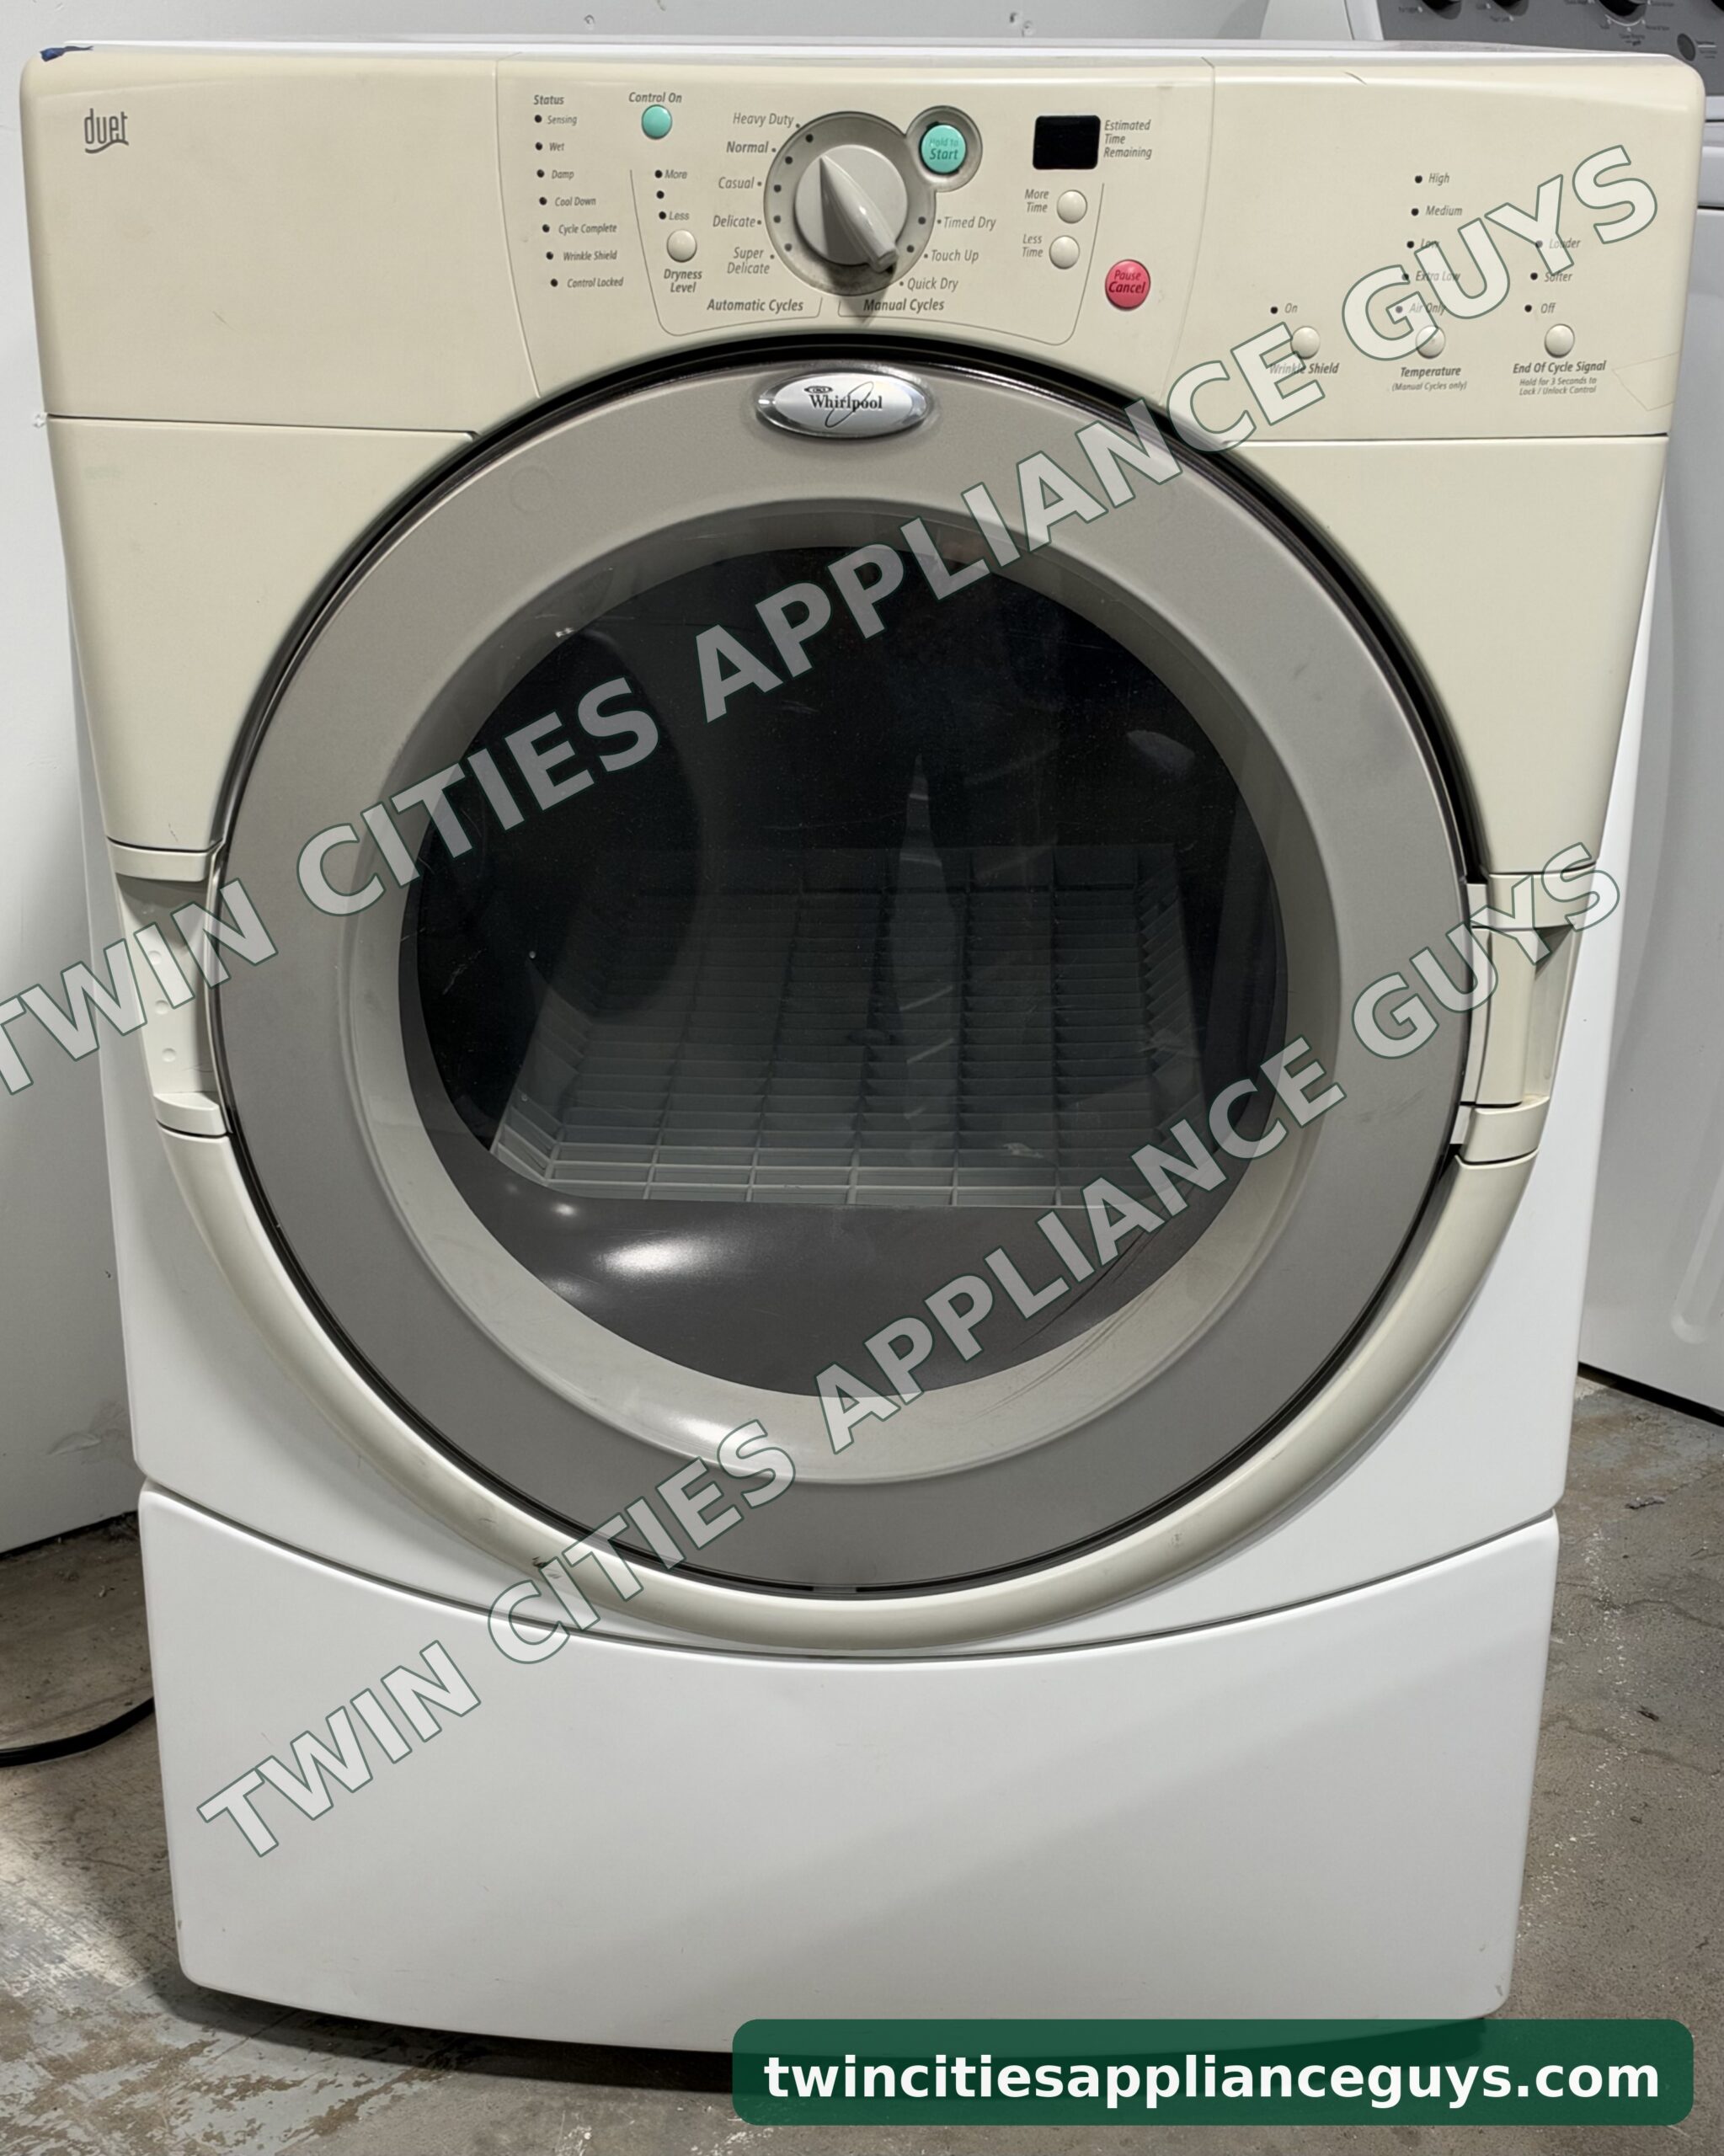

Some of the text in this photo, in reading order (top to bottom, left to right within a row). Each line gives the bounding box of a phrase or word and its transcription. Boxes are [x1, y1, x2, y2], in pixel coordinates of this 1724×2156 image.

[533, 94, 564, 105] Status
[628, 92, 682, 103] Control On
[547, 115, 578, 126] Sensing
[733, 113, 794, 127] Heavy Duty
[1104, 120, 1151, 131] Estimated
[84, 108, 129, 153] duet
[930, 137, 948, 147] Hold
[1105, 133, 1126, 144] Time
[549, 142, 565, 152] Wet
[726, 141, 768, 153] Normal
[929, 148, 958, 160] Start
[1103, 147, 1152, 160] Remaining
[552, 170, 574, 180] Damp
[665, 169, 687, 179] More
[1428, 173, 1449, 185] High
[718, 177, 754, 189] Casual
[1025, 189, 1049, 200] More
[555, 197, 596, 206] Cool Down
[1027, 202, 1048, 212] Time
[669, 211, 690, 221] Less
[1425, 205, 1463, 216] Medium
[713, 215, 755, 227] Delicate
[944, 216, 996, 231] Timed Dry
[558, 224, 617, 236] Cycle Complete
[1022, 234, 1042, 244] Less
[1420, 238, 1440, 249] Low
[1549, 238, 1581, 248] Louder
[563, 250, 617, 261] Wrinkle Shield
[734, 247, 764, 260] Super
[931, 249, 979, 264] Touch Up
[1022, 247, 1043, 258] Time
[727, 262, 771, 275] Delicate
[664, 269, 702, 281] Dryness
[1114, 270, 1141, 281] Pause
[1416, 270, 1461, 282] Extra Low
[1545, 271, 1573, 283] Softer
[567, 277, 624, 288] Control Locked
[670, 281, 697, 293] Level
[907, 277, 958, 292] Quick Dry
[1108, 281, 1146, 294] Cancel
[707, 299, 804, 314] Automatic Cycles
[863, 298, 945, 314] Manual Cycles
[1284, 303, 1298, 314] On
[1409, 302, 1446, 317] Air Only
[1540, 302, 1556, 314] Off
[1269, 362, 1340, 375] Wrinkle Shield
[1401, 366, 1462, 380] Temperature
[1513, 360, 1607, 376] End Of Cycle Signal
[1392, 380, 1467, 392] (Manual Cycles only)
[1539, 377, 1549, 386] for
[1558, 376, 1587, 385] Seconds
[809, 394, 883, 412] Whirlpool
